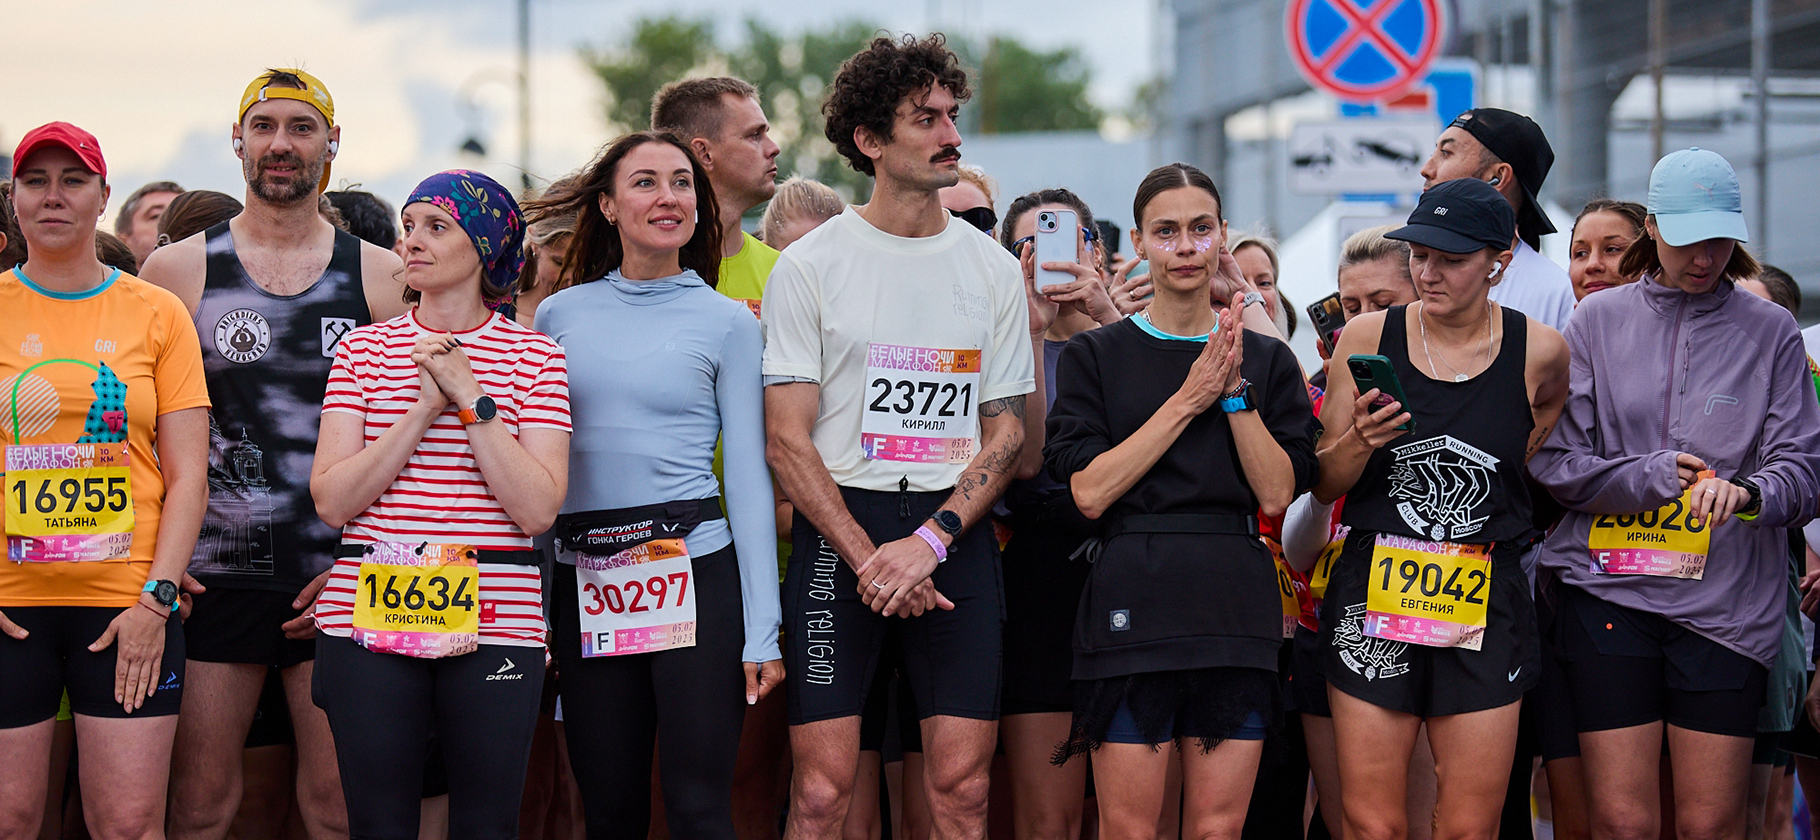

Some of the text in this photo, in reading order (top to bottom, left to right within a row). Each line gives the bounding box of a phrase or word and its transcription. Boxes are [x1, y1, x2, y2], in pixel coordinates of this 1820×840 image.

[219, 311, 263, 331] BRIGADIERS
[95, 339, 117, 353] GRi
[871, 345, 954, 364] БЕЛЫЕ НОЧИ
[871, 359, 941, 373] МАРАФОН
[869, 378, 972, 417] 23721
[902, 419, 946, 431] КИРИЛЛ
[7, 445, 95, 461] БЕЛЫЕ НОЧИ
[872, 437, 886, 457] F
[1400, 440, 1489, 464] Mikkeller RUNNING
[8, 458, 81, 471] МАРАФОН
[12, 477, 127, 514] 16955
[44, 517, 97, 528] ТАТЬЯНА
[1401, 504, 1419, 526] CLUB
[588, 520, 653, 535] ИНСТРУКТОР
[108, 533, 131, 544] 05.07
[587, 530, 652, 545] ГОНКА ГЕРОЕВ
[1627, 532, 1667, 543] ИРИНА
[21, 539, 34, 558] F
[1378, 537, 1447, 556] МАРАФОН
[364, 553, 427, 567] МАРАФОН
[1599, 552, 1611, 570] F
[1680, 554, 1704, 565] 05.07
[1378, 557, 1486, 605] 19042
[365, 573, 474, 612] 16634
[583, 571, 689, 616] 30297
[1400, 598, 1454, 615] ЕВГЕНИЯ
[385, 613, 446, 626] КРИСТИНА
[672, 622, 693, 633] 05.07
[1375, 615, 1390, 635] F
[363, 632, 376, 649] F
[449, 634, 474, 644] 05.07
[597, 632, 610, 651] F
[672, 633, 693, 645] 2025
[449, 645, 474, 655] 2025
[485, 673, 524, 681] DEMIX
